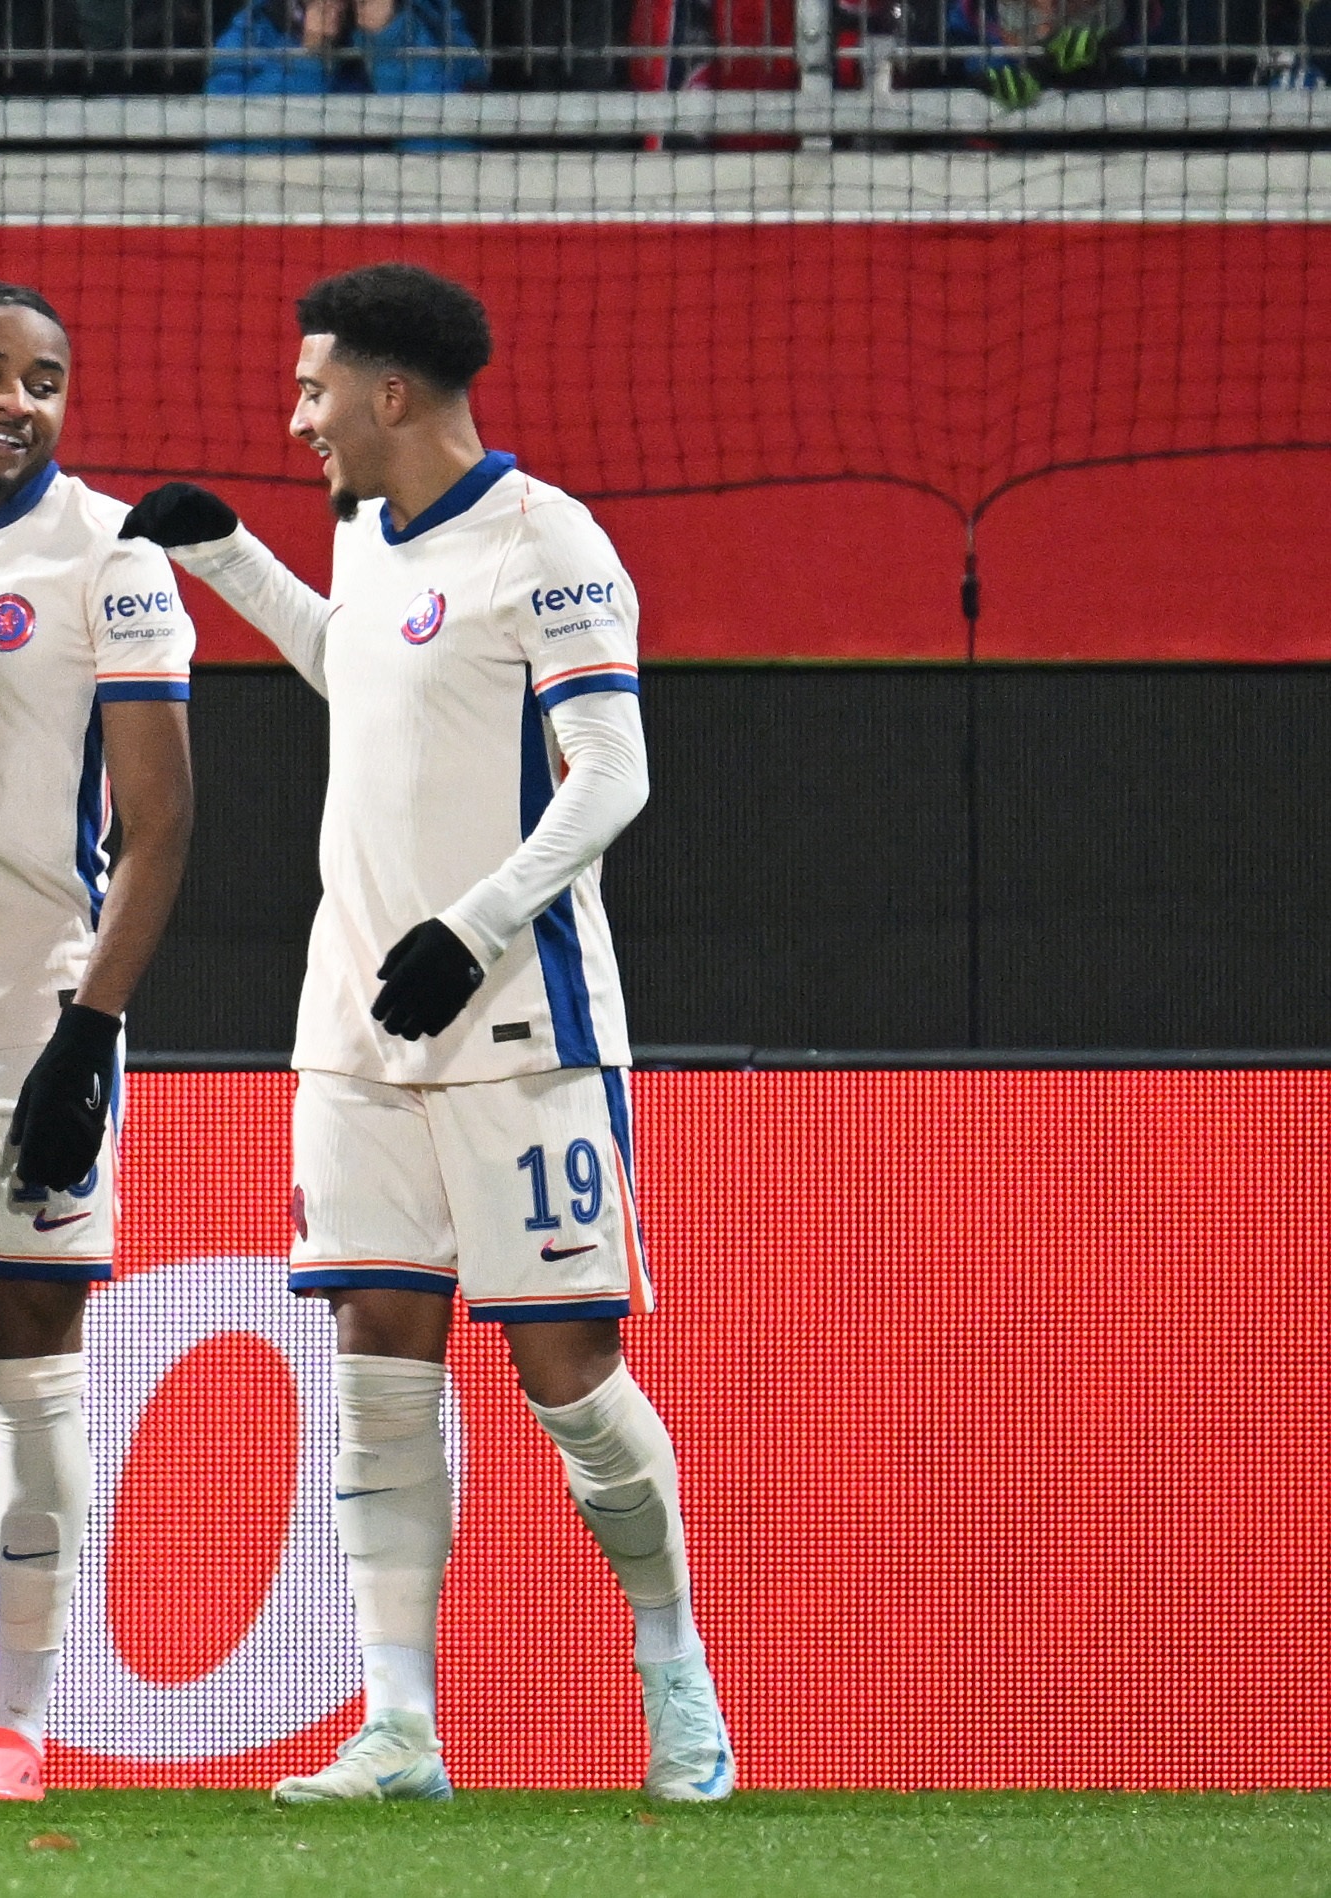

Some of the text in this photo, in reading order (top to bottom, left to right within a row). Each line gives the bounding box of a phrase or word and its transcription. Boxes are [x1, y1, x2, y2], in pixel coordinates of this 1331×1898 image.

[531, 581, 614, 617] fever
[544, 618, 615, 638] feverup.com
[517, 1138, 603, 1231] 19
